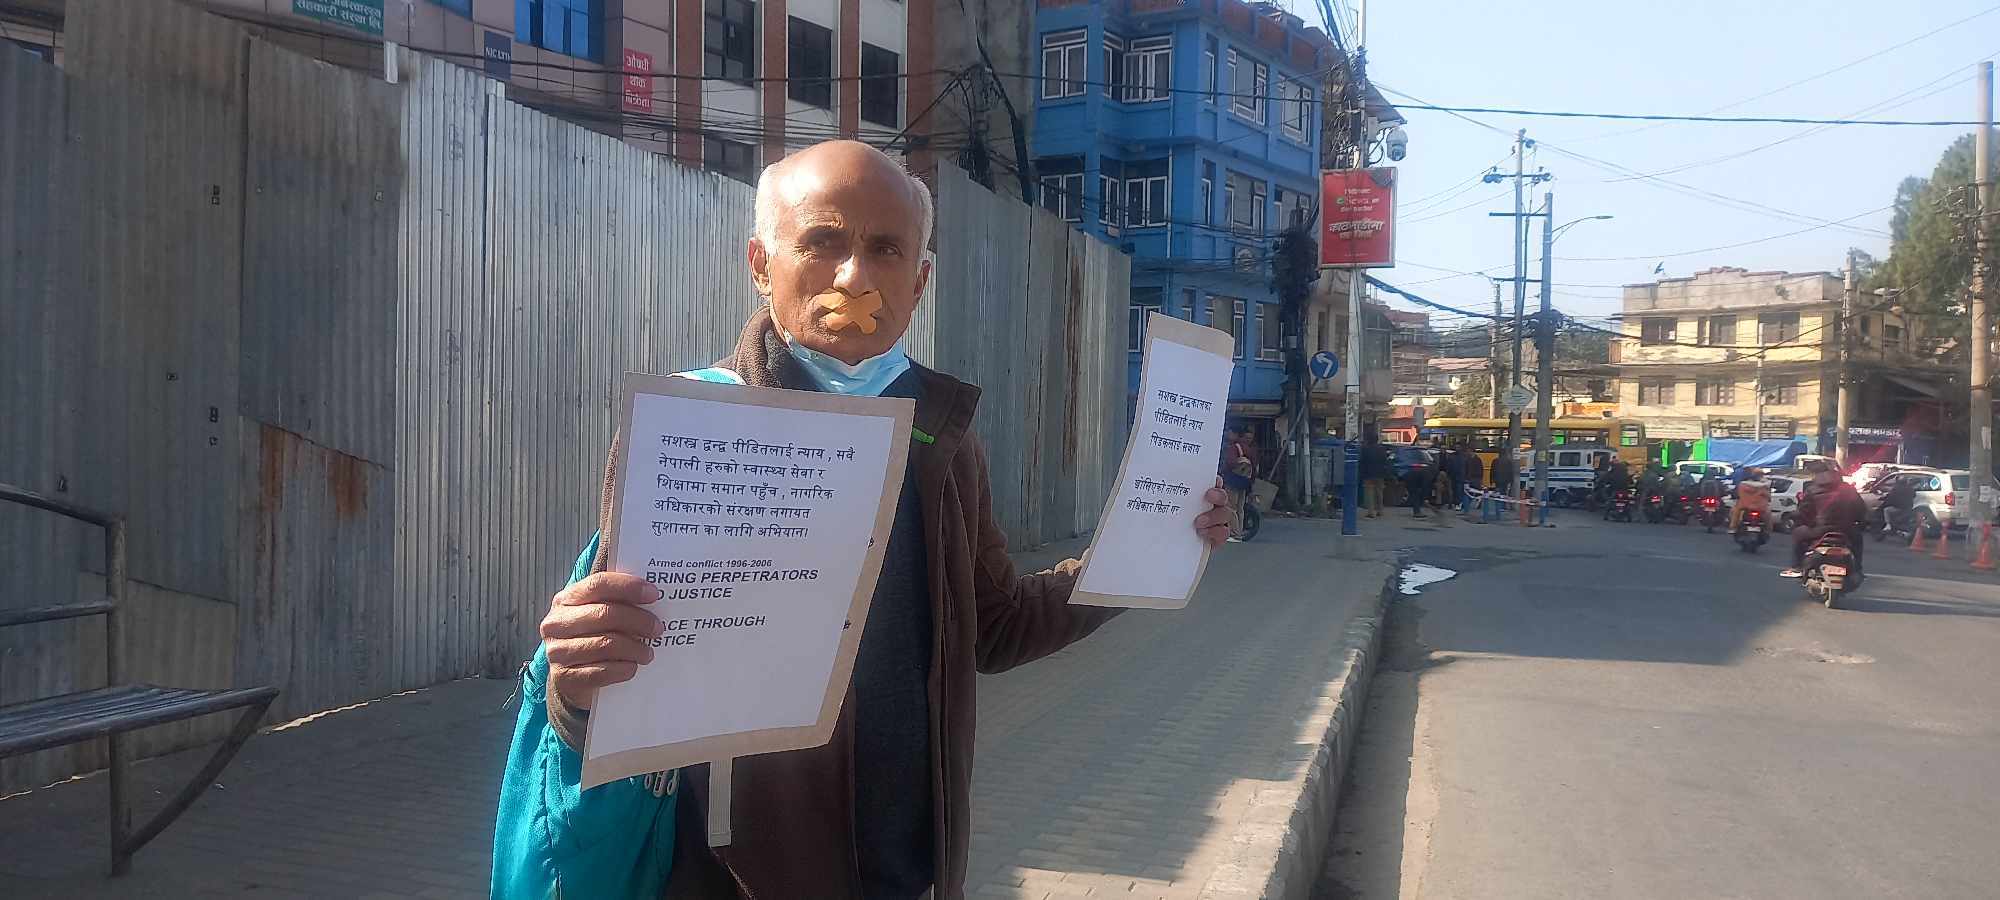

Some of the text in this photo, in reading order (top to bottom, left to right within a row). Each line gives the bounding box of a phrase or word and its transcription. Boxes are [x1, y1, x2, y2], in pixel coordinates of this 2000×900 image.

[662, 434, 699, 449] सशस्त्र
[703, 438, 728, 453] द्वन्द्व
[732, 439, 794, 459] पीडितलाई
[658, 453, 826, 479] नेपाली हरुको स्वास्थ्य सेवा र
[657, 474, 707, 493] शिक्षामा
[710, 483, 745, 495] समान
[791, 486, 835, 500] नागरिक
[654, 497, 812, 519] अधिकारको संरक्षण लगायत
[651, 520, 699, 537] सुशासन
[703, 524, 720, 536] का
[724, 523, 754, 537] लागि
[648, 558, 772, 568] Armed conflict 1996-2006
[646, 569, 819, 584] BRING PERPETRATORS
[669, 587, 733, 601] JUSTICE
[693, 615, 766, 630] THROUGH
